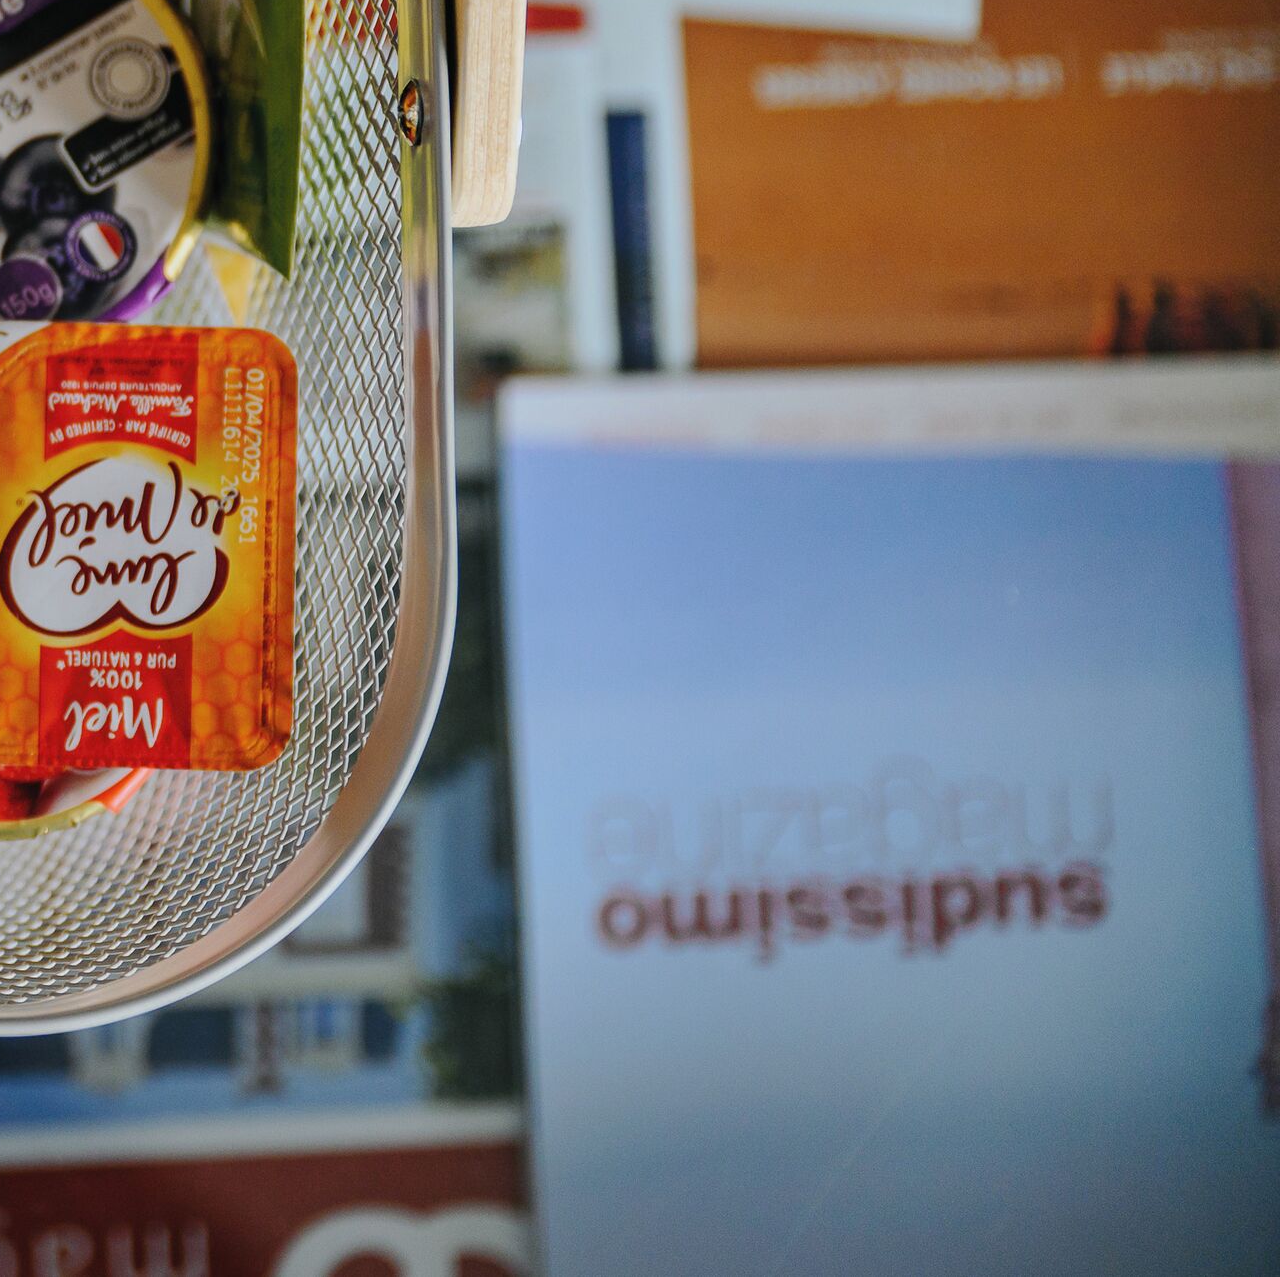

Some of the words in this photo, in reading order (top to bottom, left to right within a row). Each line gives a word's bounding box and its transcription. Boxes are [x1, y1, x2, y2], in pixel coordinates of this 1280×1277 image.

[0, 279, 58, 319] 150g
[48, 391, 127, 415] Michaud
[130, 395, 194, 417] Famille
[49, 427, 63, 444] BY
[65, 419, 116, 438] CERTIFIED
[126, 421, 148, 434] PAR
[150, 422, 191, 449] CERTIFIÉ
[241, 368, 266, 483] 01/04/2025
[54, 551, 197, 616] lune
[148, 652, 177, 670] PUR
[90, 668, 143, 691] 100%
[64, 696, 165, 752] Miel
[589, 756, 1112, 886] magazine
[595, 865, 1107, 961] sudissimo
